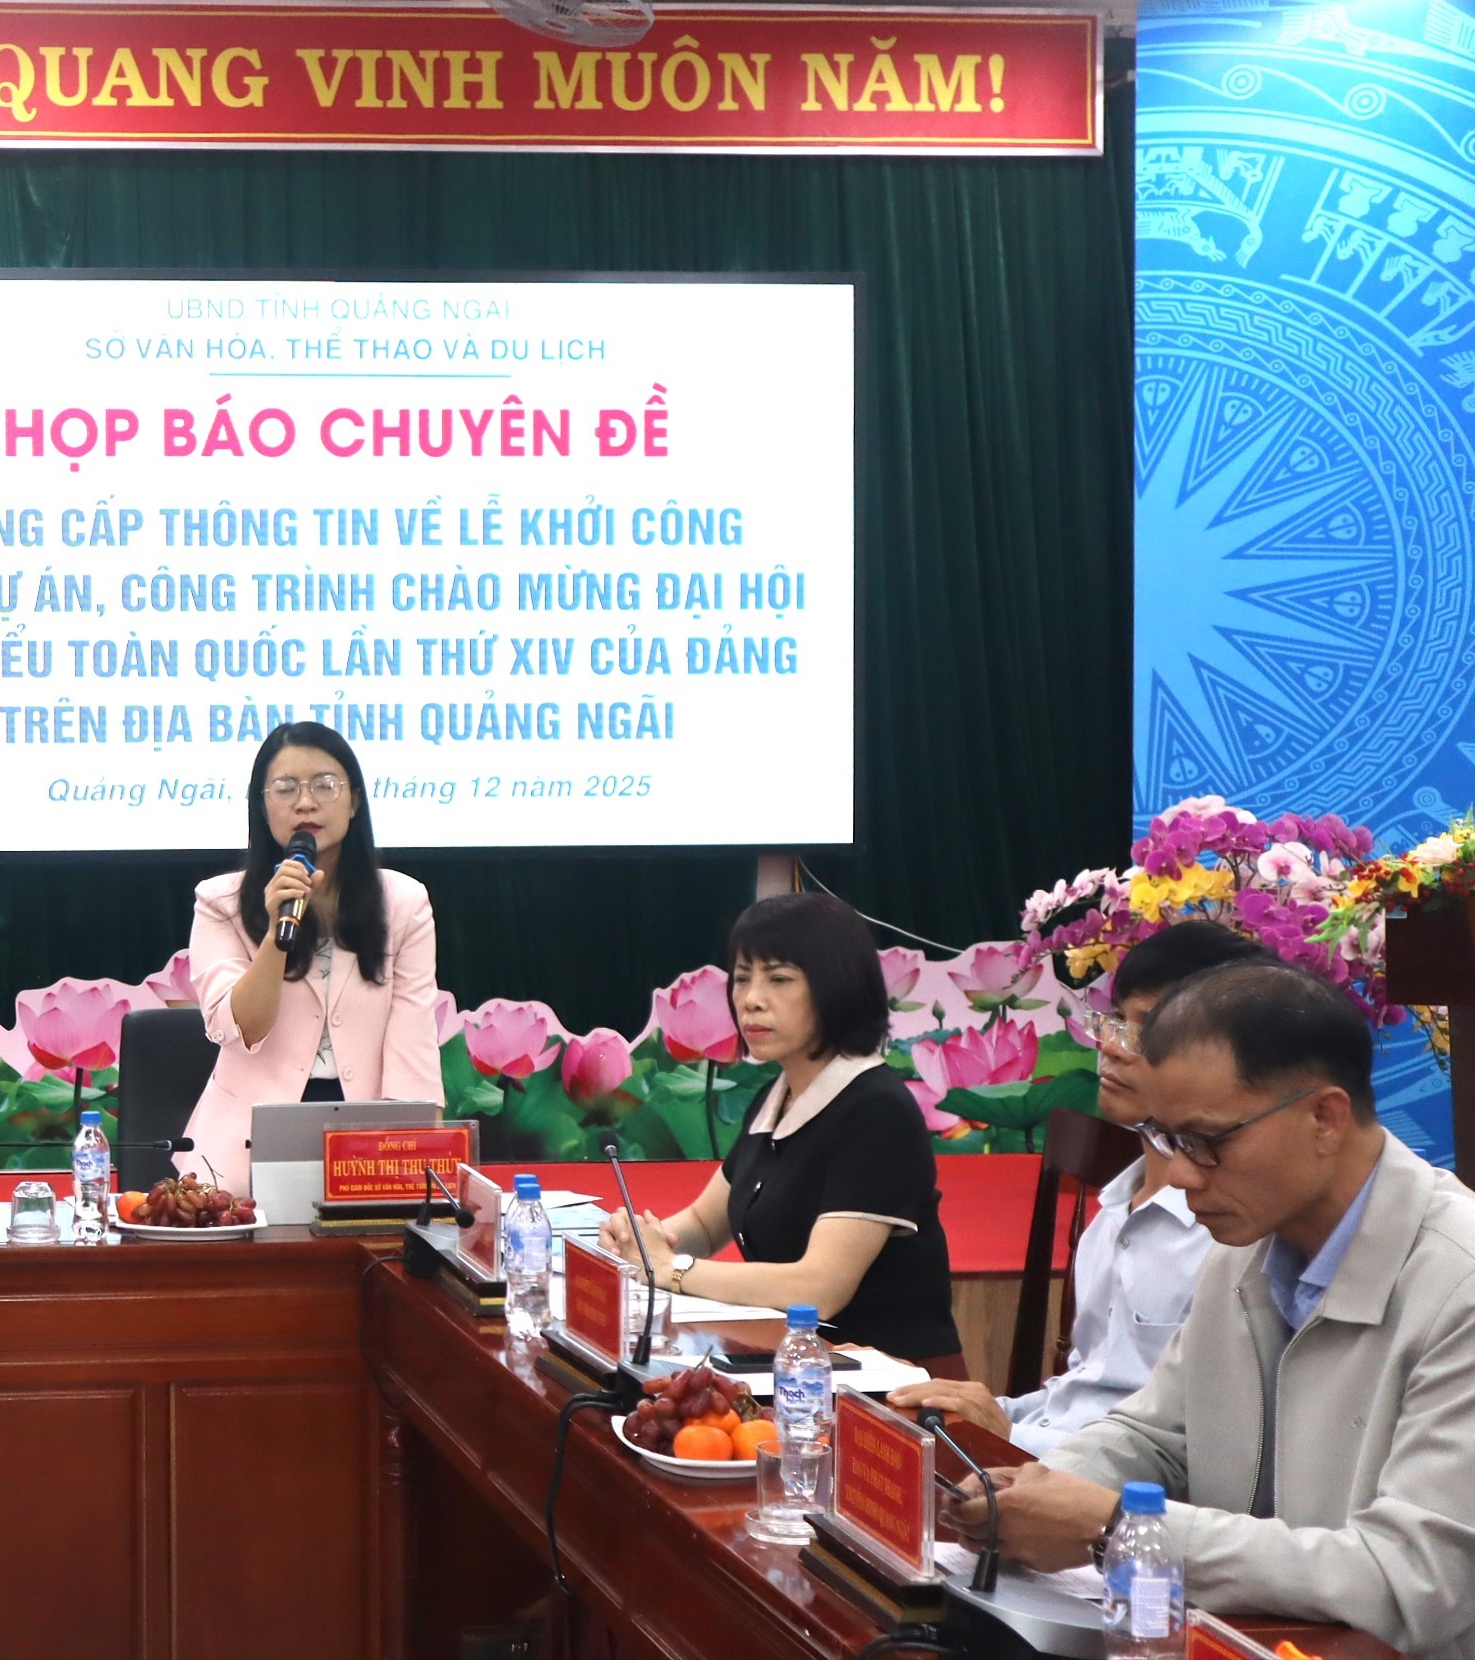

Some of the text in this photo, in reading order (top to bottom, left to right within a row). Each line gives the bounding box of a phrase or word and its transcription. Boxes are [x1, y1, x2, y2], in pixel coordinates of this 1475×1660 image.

[298, 48, 504, 110] VINH
[534, 35, 771, 112] MUÔN
[801, 38, 1006, 113] NĂM!
[167, 297, 245, 320] UBND
[135, 332, 195, 360] VĂN
[285, 325, 343, 360] THỂ
[352, 337, 434, 361] THAO
[442, 331, 480, 360] VÀ
[491, 338, 530, 361] DU
[541, 338, 606, 365] LỊCH
[4, 381, 669, 473] HỌP BÁO CHUYÊN ĐỀ
[61, 494, 145, 548] CẤP
[158, 499, 299, 548] THÔNG
[312, 507, 380, 547] TIN
[394, 494, 444, 547] VỀ
[459, 492, 505, 547] LỄ
[519, 493, 616, 547] KHỞI
[631, 498, 744, 547] CÔNG
[33, 565, 106, 618] ÁN,
[121, 564, 237, 613] CÔNG
[251, 564, 376, 613] TRÌNH
[391, 563, 502, 612] CHÀO
[517, 563, 642, 612] MỪNG
[655, 571, 724, 620] ĐẠI
[739, 563, 806, 620] HỘI
[67, 630, 179, 679] TOÀN
[194, 623, 307, 683] QUỐC
[322, 623, 402, 678] LẦN
[416, 629, 500, 678] THỨ
[509, 637, 576, 677] XIV
[590, 623, 673, 677] CỦA
[685, 622, 798, 676] ĐẢNG
[0, 696, 108, 744] TRÊN
[121, 703, 193, 752] ĐỊA
[420, 689, 561, 746] QUẢNG
[577, 693, 675, 740] NGÃI
[372, 775, 458, 805] tháng
[470, 775, 502, 798] 12
[583, 774, 653, 798] 2025
[333, 1154, 375, 1177] HUỲNH
[378, 1159, 399, 1179] THỊ
